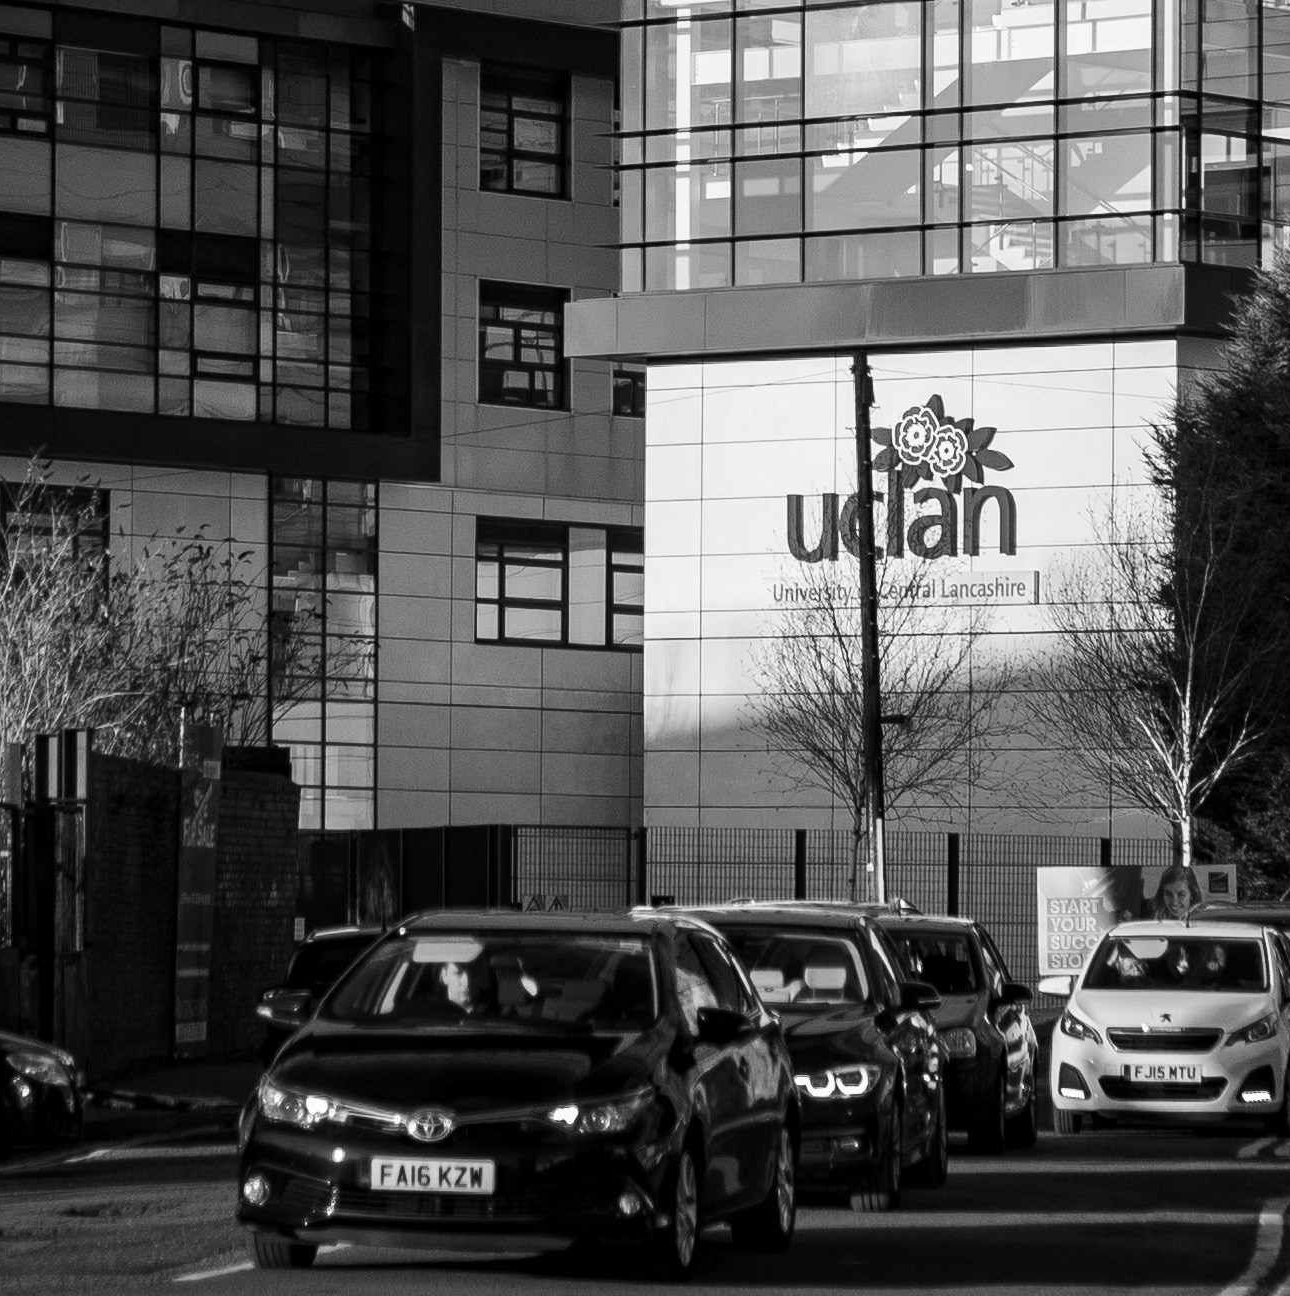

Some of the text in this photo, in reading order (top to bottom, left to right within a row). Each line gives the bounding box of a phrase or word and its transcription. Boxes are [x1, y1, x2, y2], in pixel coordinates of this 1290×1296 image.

[786, 470, 1018, 563] uclan
[772, 580, 853, 605] University
[940, 576, 1027, 600] Lancashire
[1049, 898, 1100, 915] START
[1050, 916, 1097, 933] YOUR
[1050, 934, 1102, 951] SUCC
[1050, 953, 1086, 969] STO
[1133, 1064, 1198, 1081] FJ15 MTU
[379, 1163, 484, 1190] FA16 KZW
